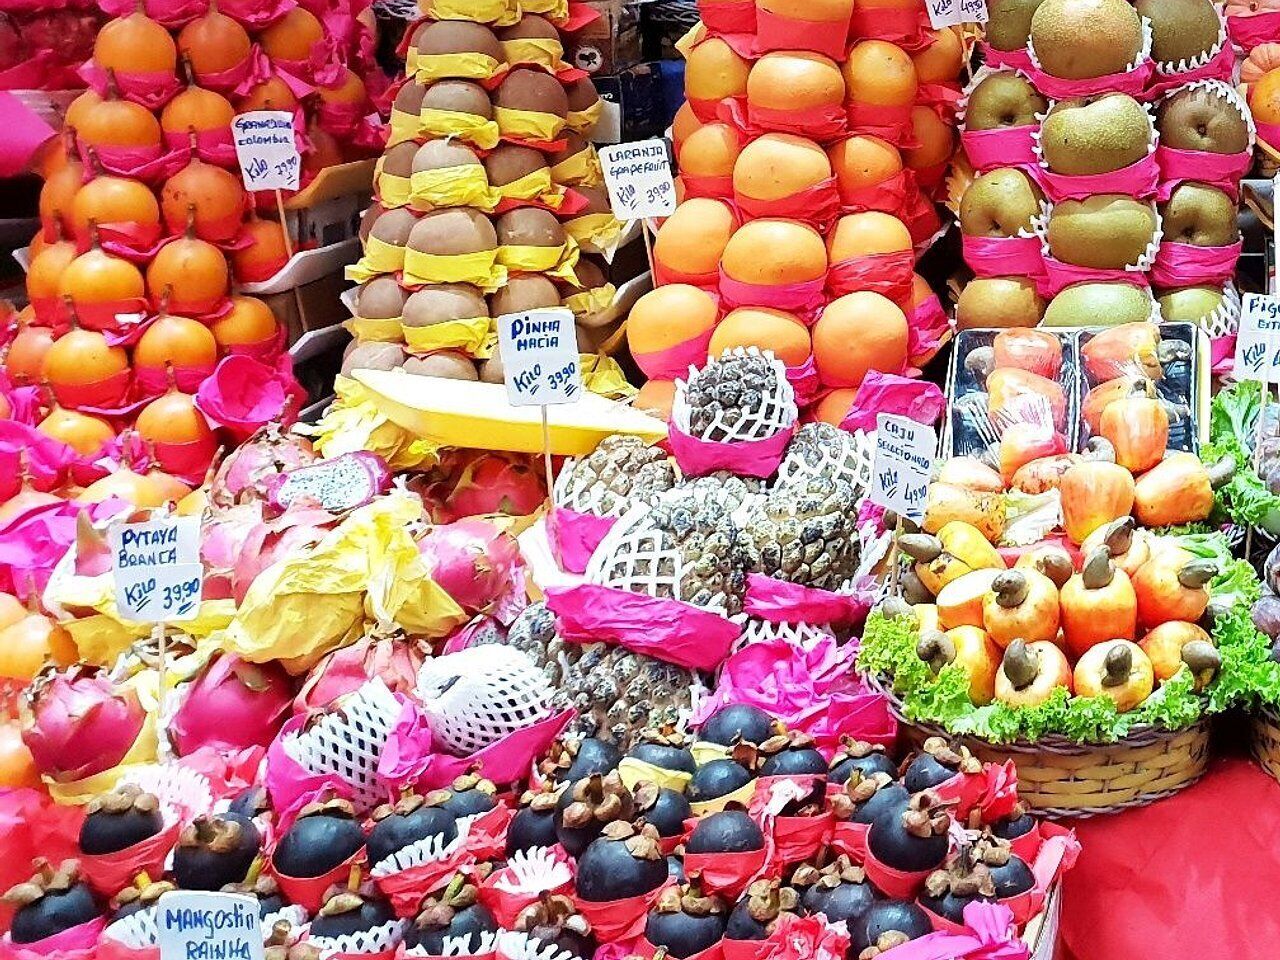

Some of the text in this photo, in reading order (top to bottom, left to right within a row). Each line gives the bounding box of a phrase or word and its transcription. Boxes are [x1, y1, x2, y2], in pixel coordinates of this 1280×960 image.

[609, 147, 663, 162] LARANJA
[885, 421, 914, 441] CAJU
[119, 547, 177, 568] BRANCA
